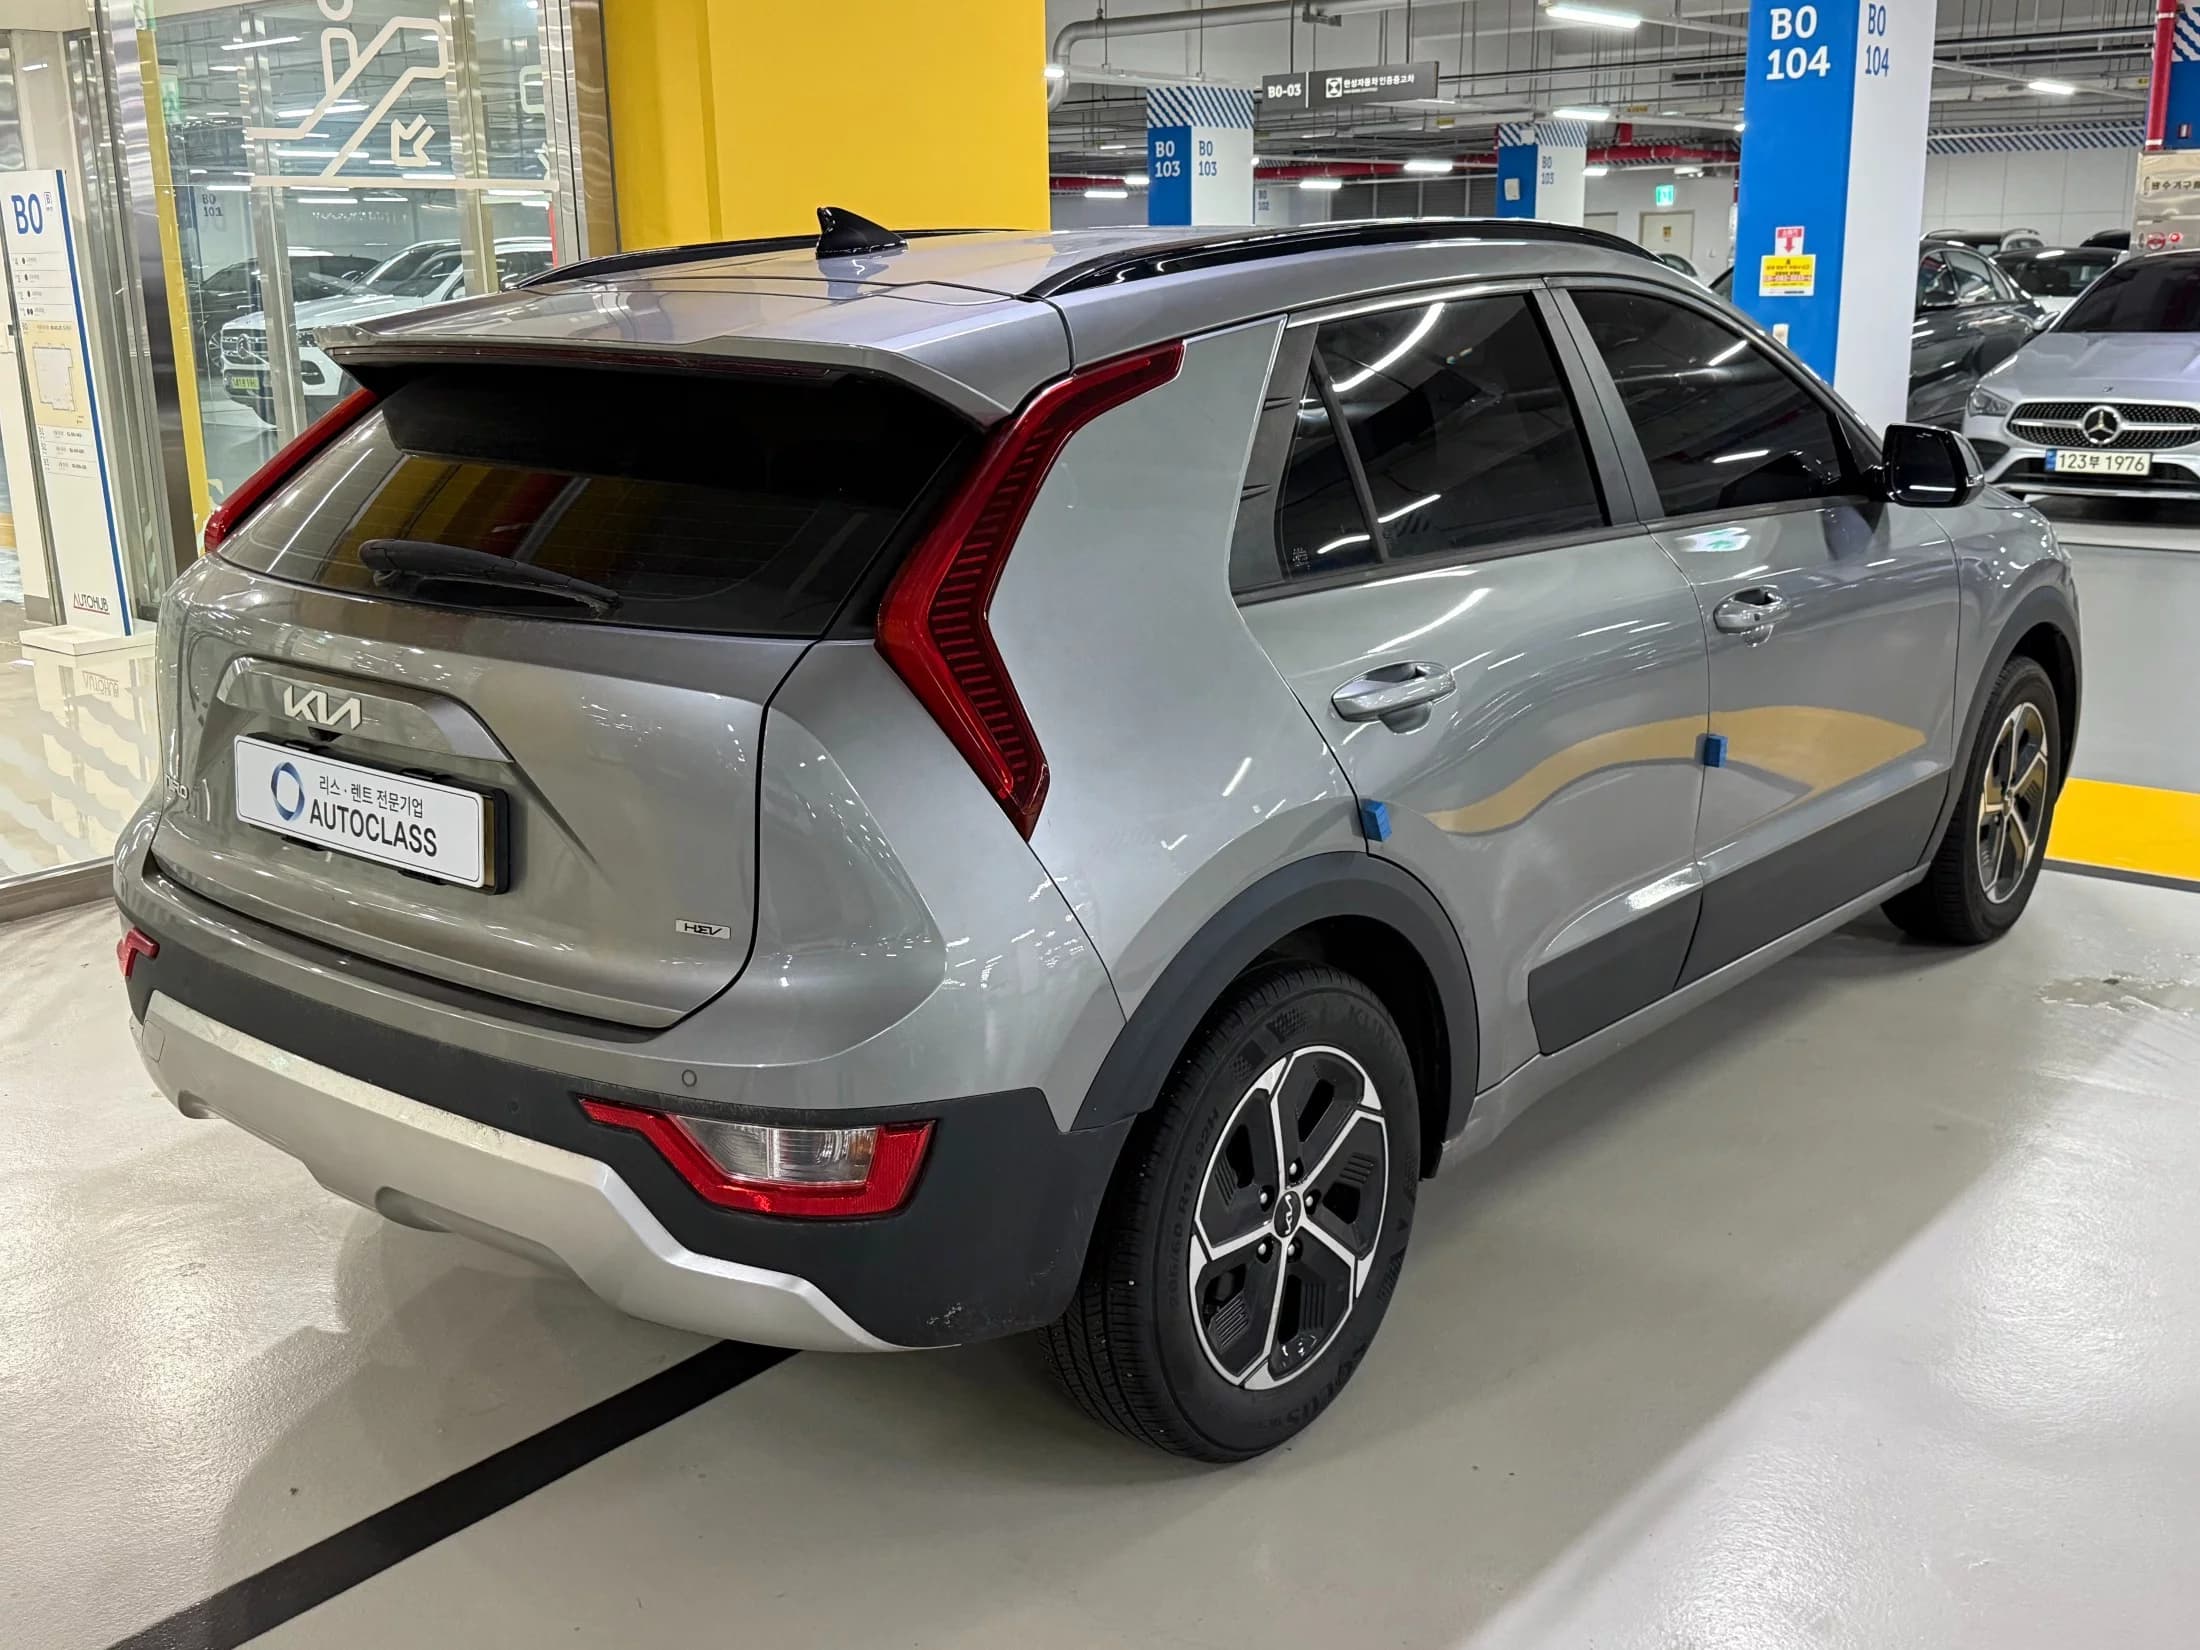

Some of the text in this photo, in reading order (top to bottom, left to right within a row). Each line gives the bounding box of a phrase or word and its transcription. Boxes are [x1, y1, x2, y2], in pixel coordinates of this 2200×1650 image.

[1766, 46, 1831, 80] 104
[1865, 45, 1889, 77] 104
[1155, 161, 1181, 177] 103
[1199, 161, 1217, 176] 103
[2059, 454, 2100, 470] 123부
[2105, 455, 2145, 472] 1976
[74, 592, 109, 612] AUTOHUB
[284, 685, 361, 730] KIA
[376, 790, 423, 819] 전문기업
[309, 798, 438, 857] AUTOCLASS
[684, 923, 723, 936] HEV
